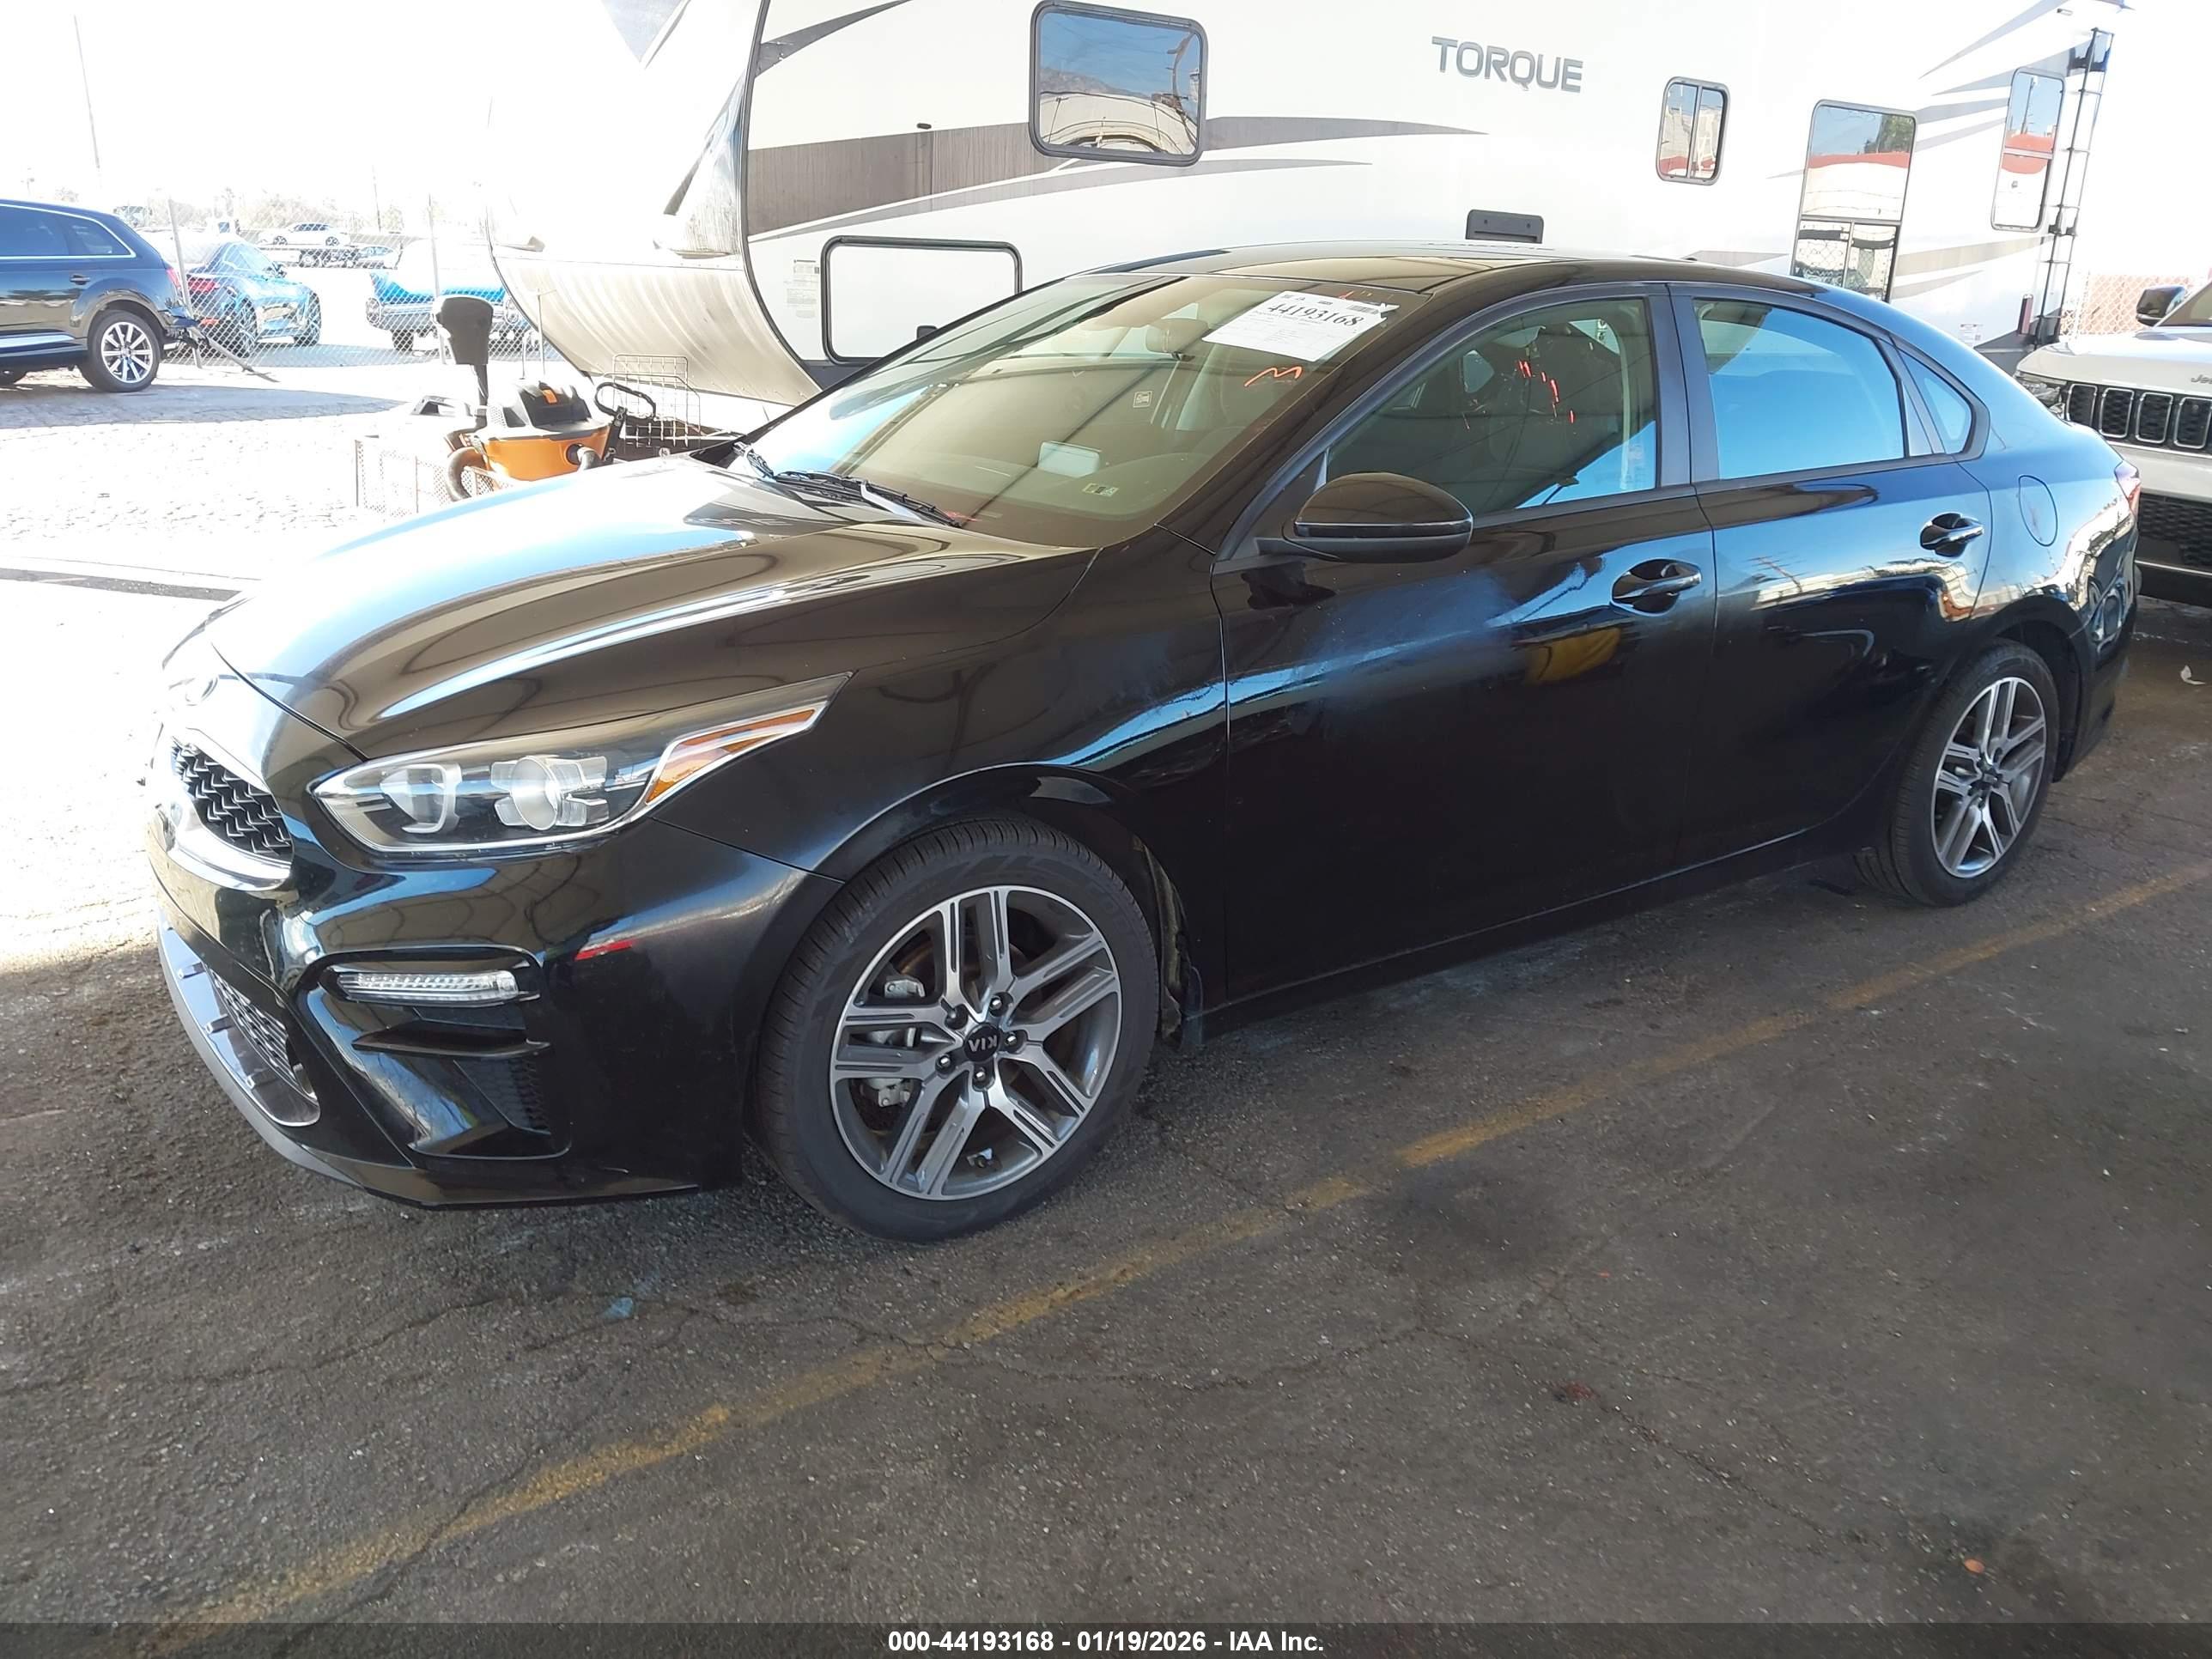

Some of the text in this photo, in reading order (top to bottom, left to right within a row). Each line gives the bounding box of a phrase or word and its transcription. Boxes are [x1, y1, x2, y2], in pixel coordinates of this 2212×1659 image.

[1431, 36, 1583, 93] TORQUE
[1267, 302, 1365, 327] 44193168
[969, 1035, 997, 1052] KIA
